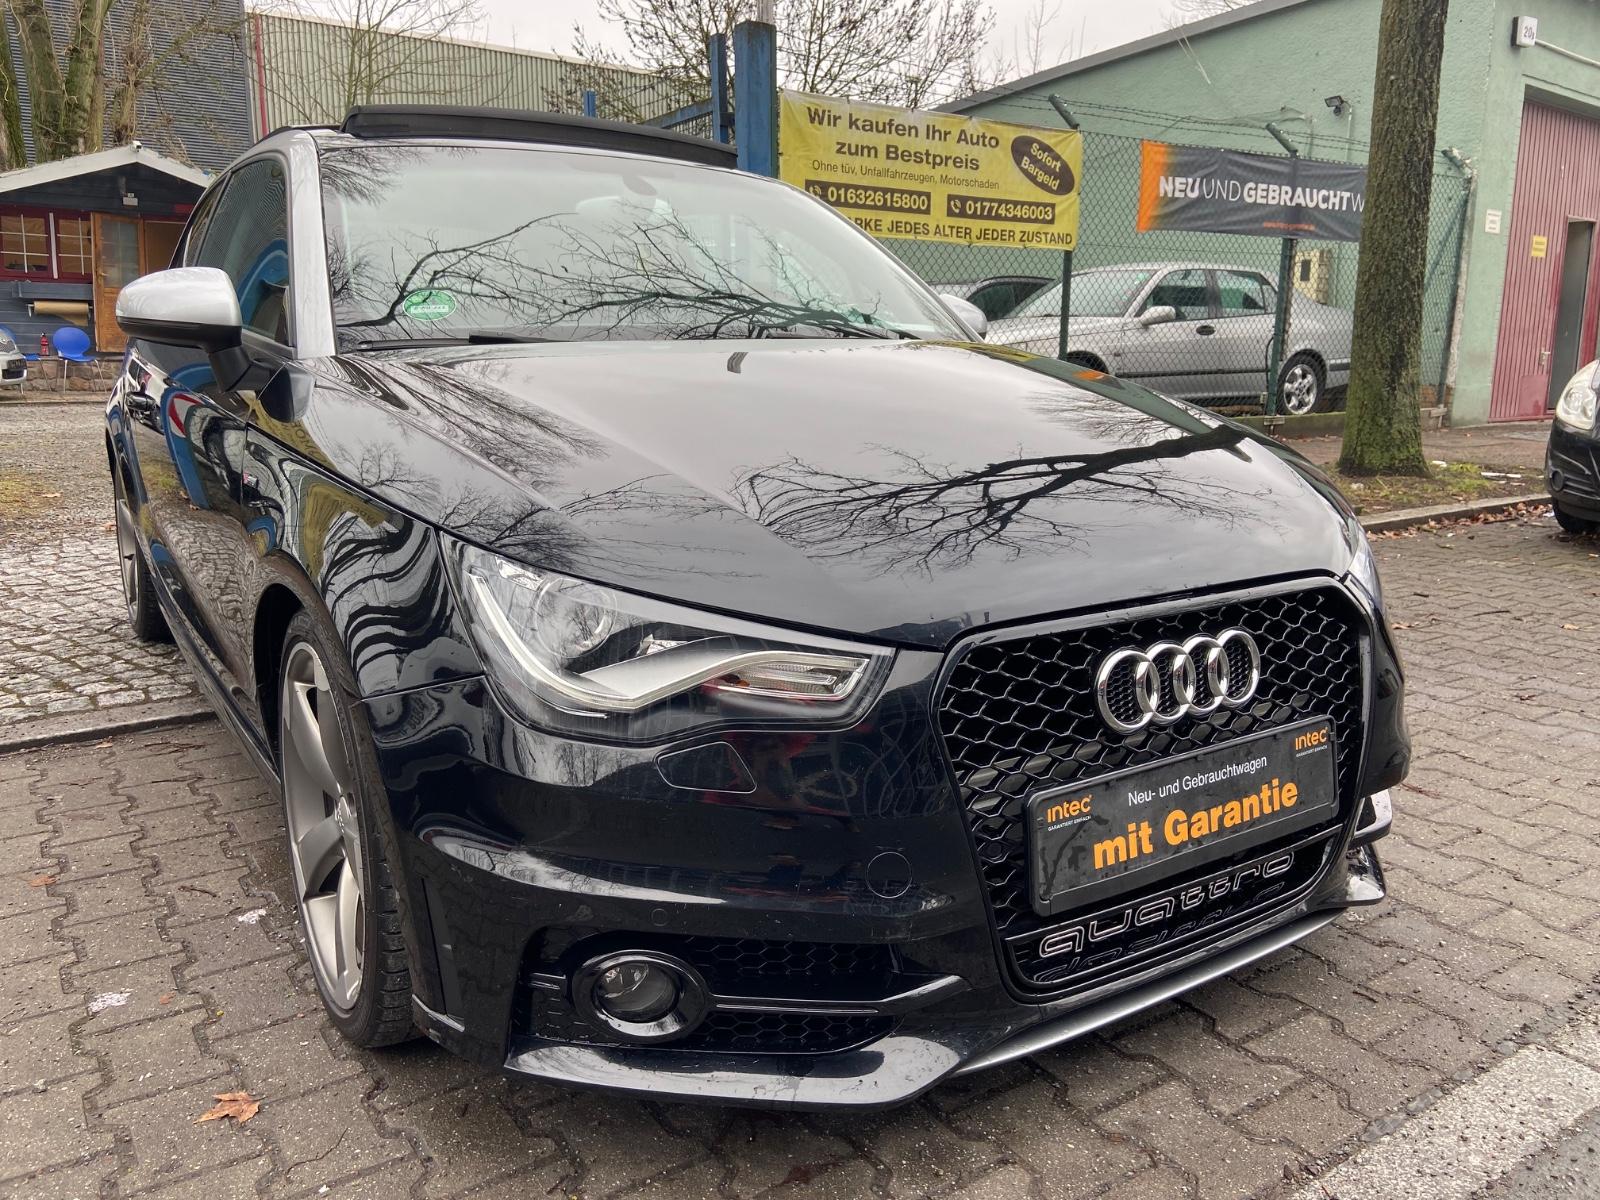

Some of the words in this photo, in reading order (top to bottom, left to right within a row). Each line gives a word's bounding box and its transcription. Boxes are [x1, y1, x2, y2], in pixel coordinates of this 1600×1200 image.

[806, 106, 842, 128] Wir
[848, 113, 919, 138] kaufen
[925, 124, 952, 142] Ihr
[956, 129, 1000, 148] Auto
[835, 141, 879, 158] zum
[886, 144, 980, 171] Bestpreis
[1030, 142, 1062, 173] Sofort
[812, 160, 839, 173] Ohne
[860, 166, 938, 184] Unfallfahrzeugen,
[940, 174, 1000, 190] Motorschaden
[1020, 156, 1061, 191] Bargeld
[1159, 175, 1201, 199] NEU
[1203, 178, 1241, 201] UND
[827, 186, 929, 210] 01632615800
[965, 200, 1053, 220] 01774346003
[848, 217, 883, 232] RKE
[887, 219, 930, 236] JEDES
[934, 224, 972, 240] ALTER
[976, 228, 1016, 242] JEDER
[1018, 230, 1073, 245] ZUSTAND
[1128, 790, 1156, 806] Neu-
[1159, 779, 1180, 798] und
[1182, 756, 1268, 788] Gebrauchtwagen
[1094, 820, 1154, 870] mit
[1164, 777, 1298, 846] Garantie
[1039, 851, 1295, 957] quattro
